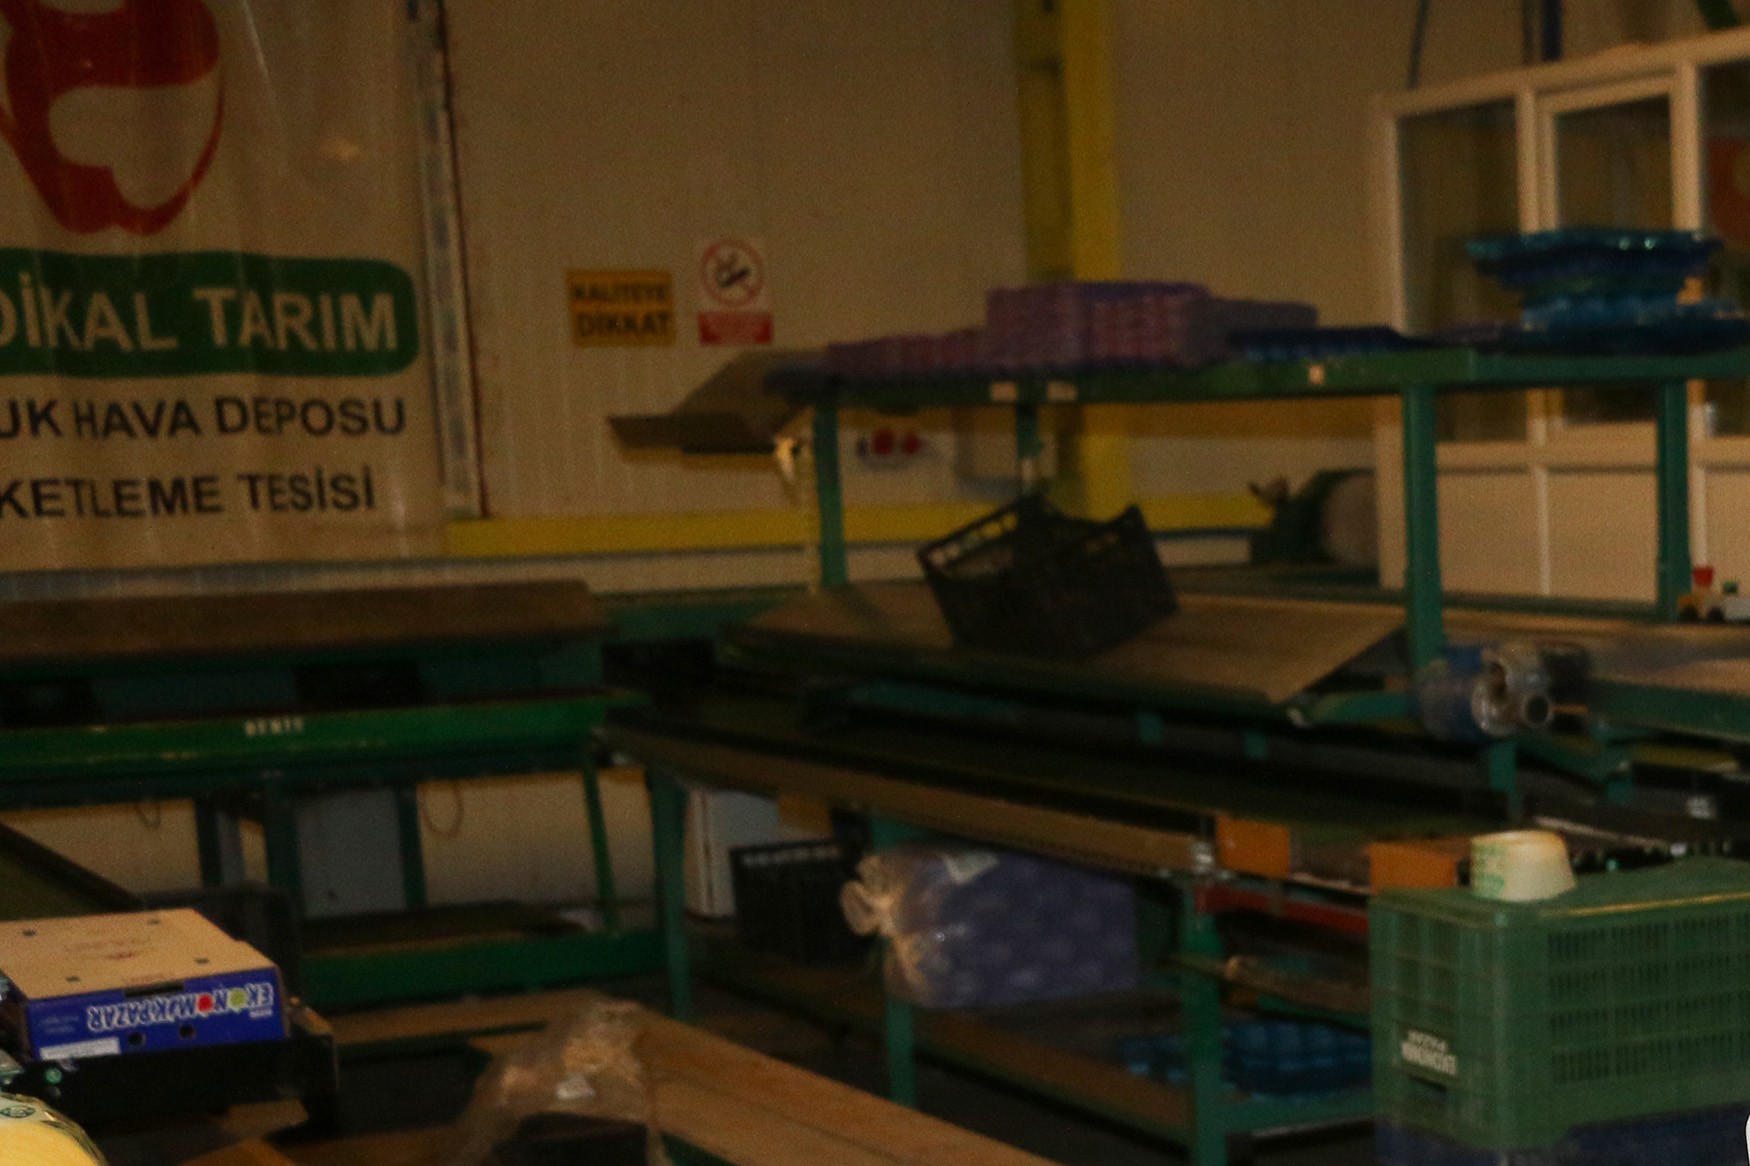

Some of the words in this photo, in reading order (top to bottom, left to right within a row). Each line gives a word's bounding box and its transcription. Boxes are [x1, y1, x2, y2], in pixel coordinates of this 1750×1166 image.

[193, 286, 396, 351] TARIM
[74, 399, 200, 438] HAVA
[215, 396, 406, 437] DEPOSU
[237, 464, 376, 512] TESİSİ
